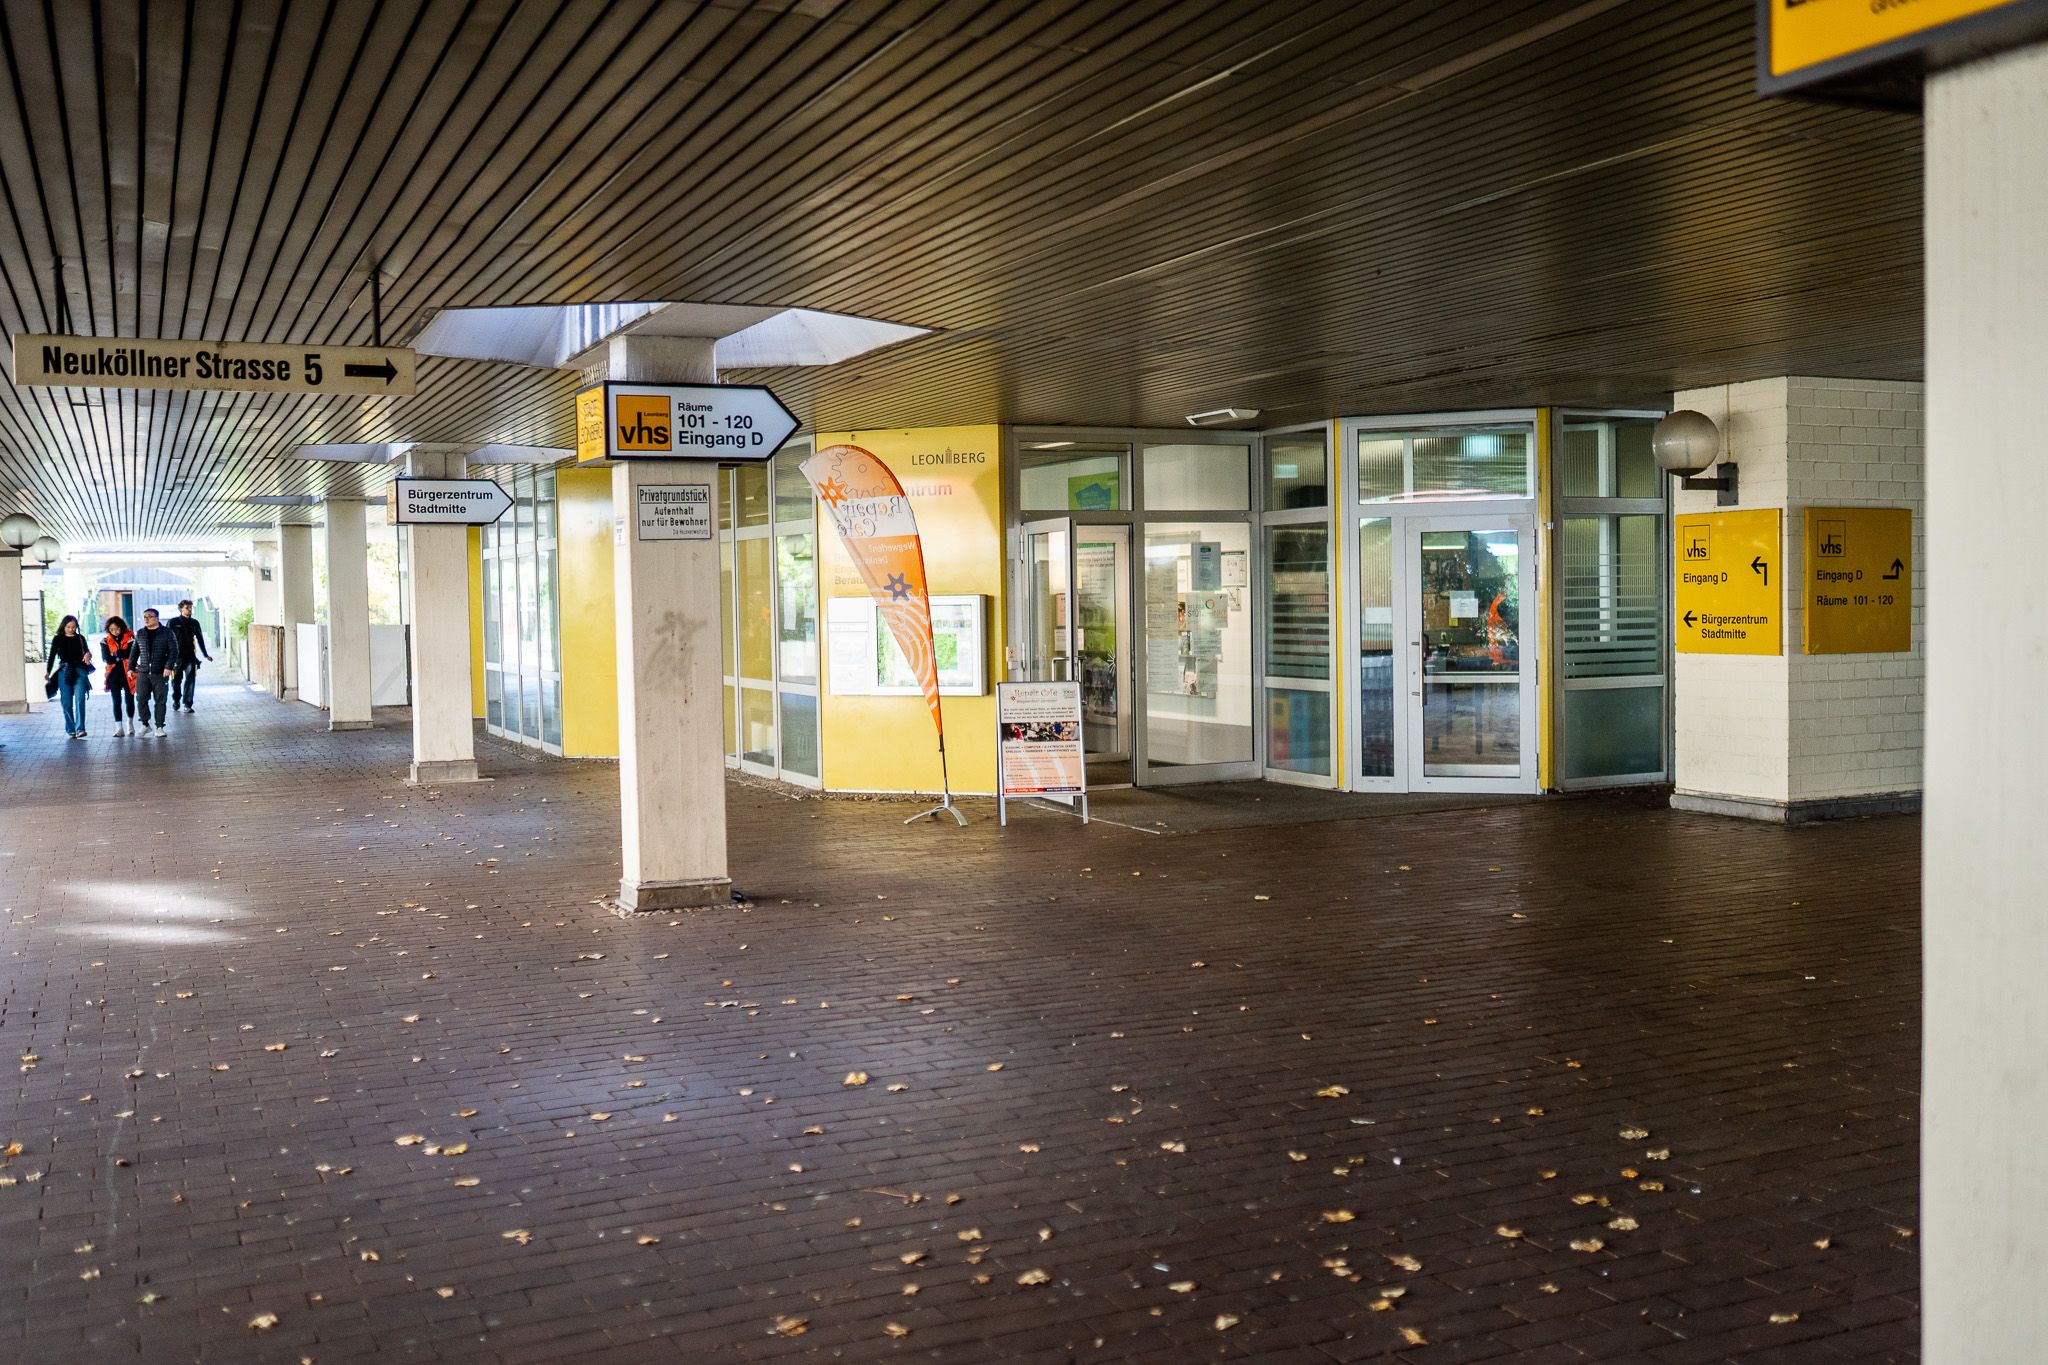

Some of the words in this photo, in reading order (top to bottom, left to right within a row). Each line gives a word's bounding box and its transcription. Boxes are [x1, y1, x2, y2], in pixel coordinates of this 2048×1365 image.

[42, 345, 191, 379] Neuköllner
[195, 350, 291, 381] Strasse
[304, 353, 323, 385] 5
[678, 402, 713, 412] Räume
[678, 414, 705, 428] 101
[724, 415, 753, 429] 120
[620, 411, 669, 445] vhs
[678, 430, 746, 448] Eingang
[752, 432, 764, 445] D
[408, 489, 493, 501] Bürgerzentrum
[640, 488, 708, 504] Privatgrundstück
[408, 504, 467, 514] Stadtmitte
[654, 506, 694, 515] Aufenthalt
[641, 519, 655, 527] nur
[657, 517, 668, 527] für
[670, 517, 708, 526] Bewohner
[1686, 538, 1707, 558] vhs
[1820, 534, 1842, 554] vhs
[834, 576, 865, 585] Beratu
[1683, 573, 1718, 585] Eingang
[1721, 573, 1728, 582] D
[1816, 570, 1853, 583] Eingang
[1856, 569, 1863, 579] D
[1816, 594, 1848, 606] Räume
[1853, 595, 1869, 605] 101
[1878, 595, 1894, 605] 120
[1701, 613, 1768, 626] Bürgerzentrum
[1701, 628, 1747, 639] Stadtmitte
